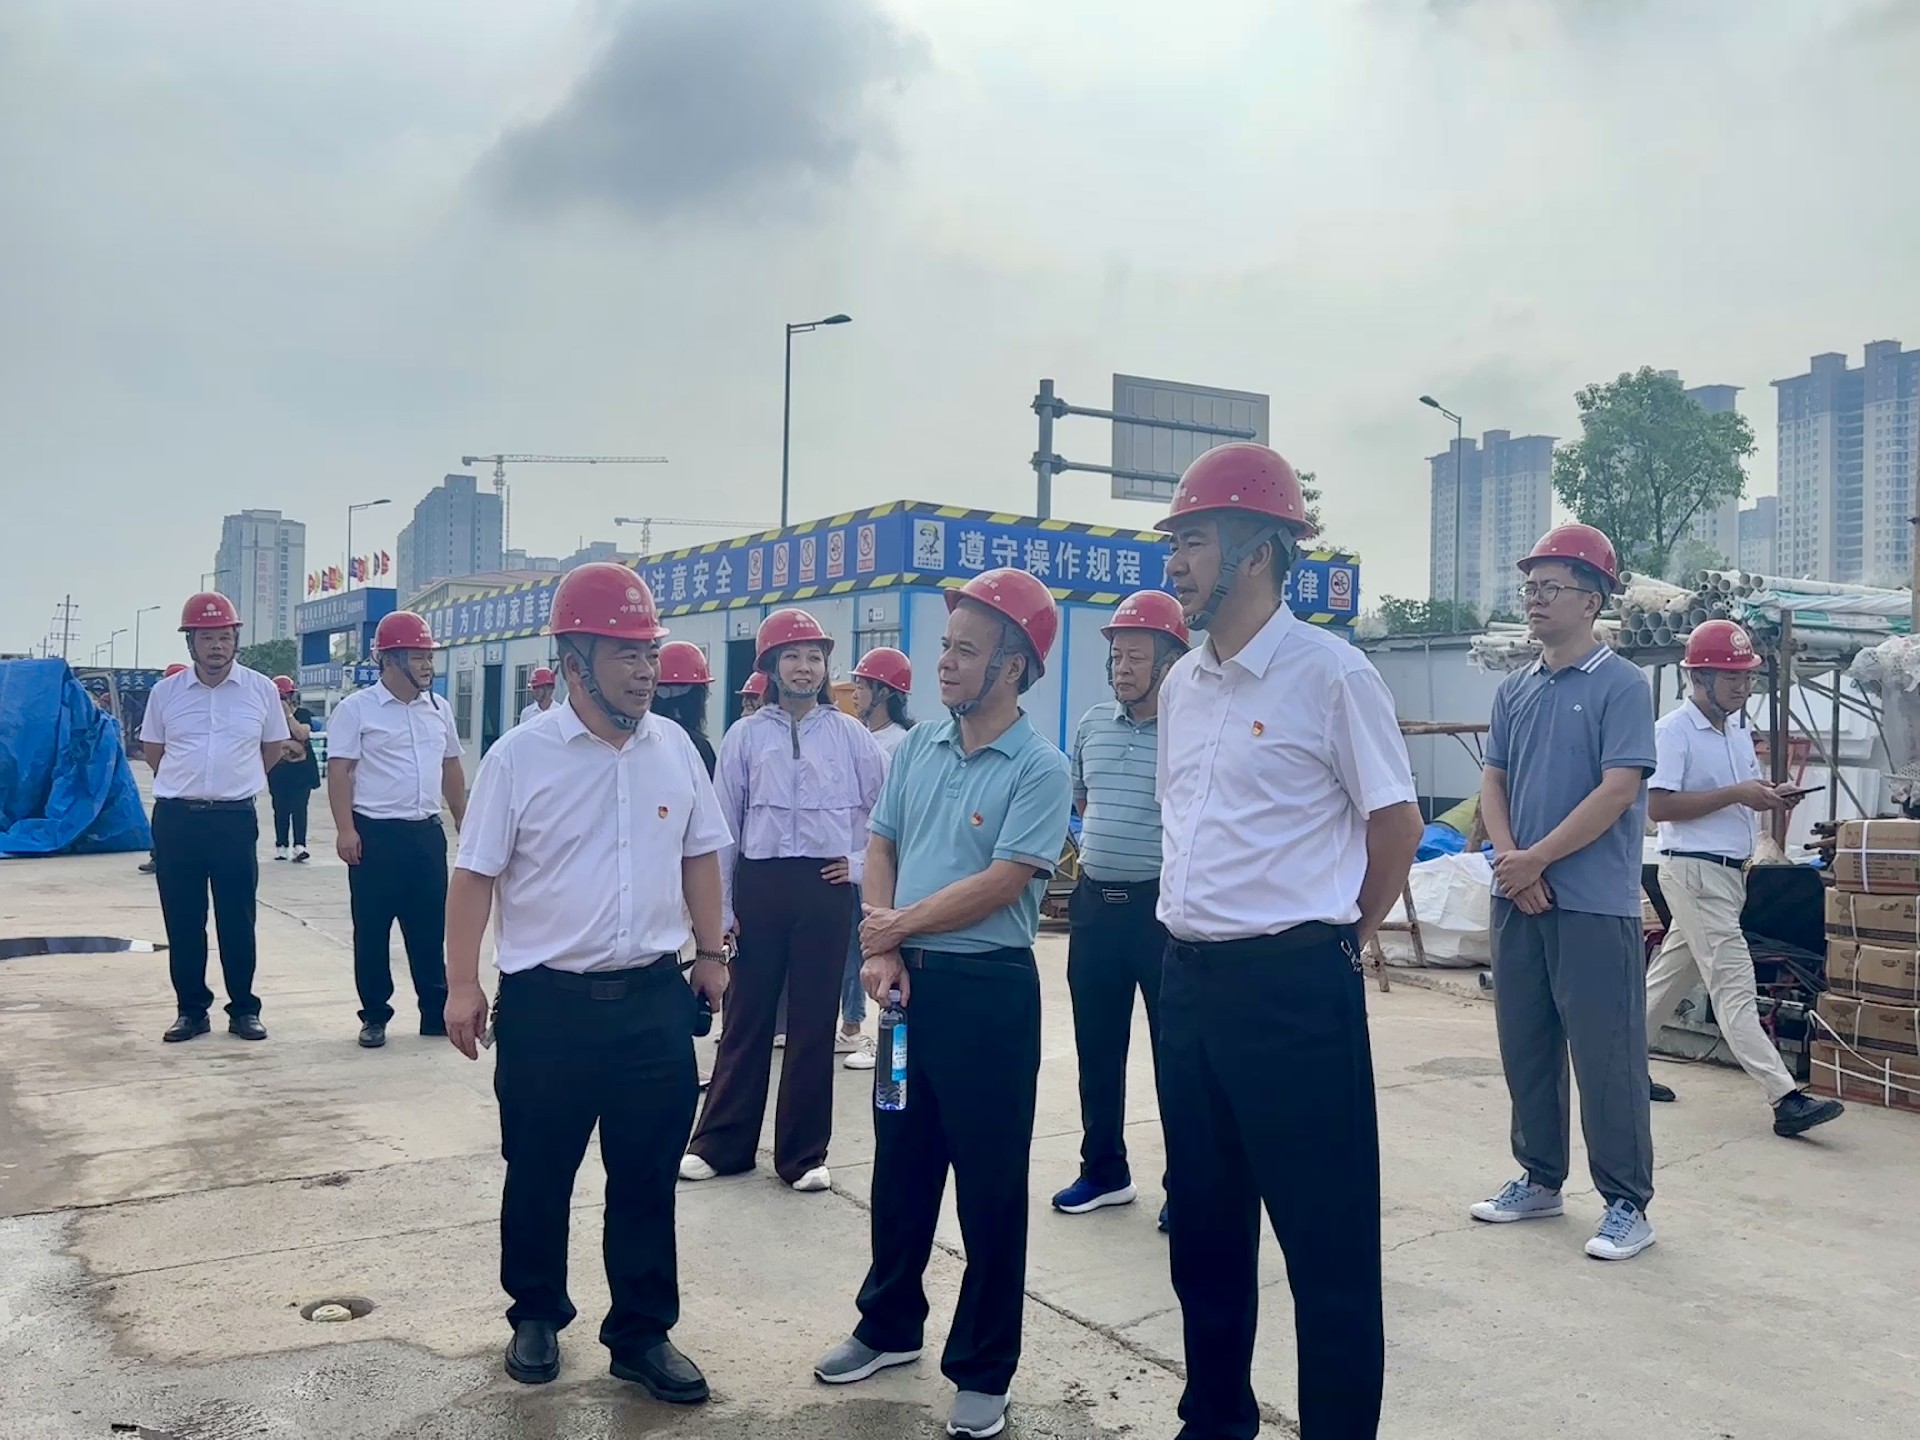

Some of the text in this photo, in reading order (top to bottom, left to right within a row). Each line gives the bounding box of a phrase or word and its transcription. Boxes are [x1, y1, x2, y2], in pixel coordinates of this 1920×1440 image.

[643, 554, 733, 603] 注意安全
[958, 529, 1141, 586] 遵守操作规程
